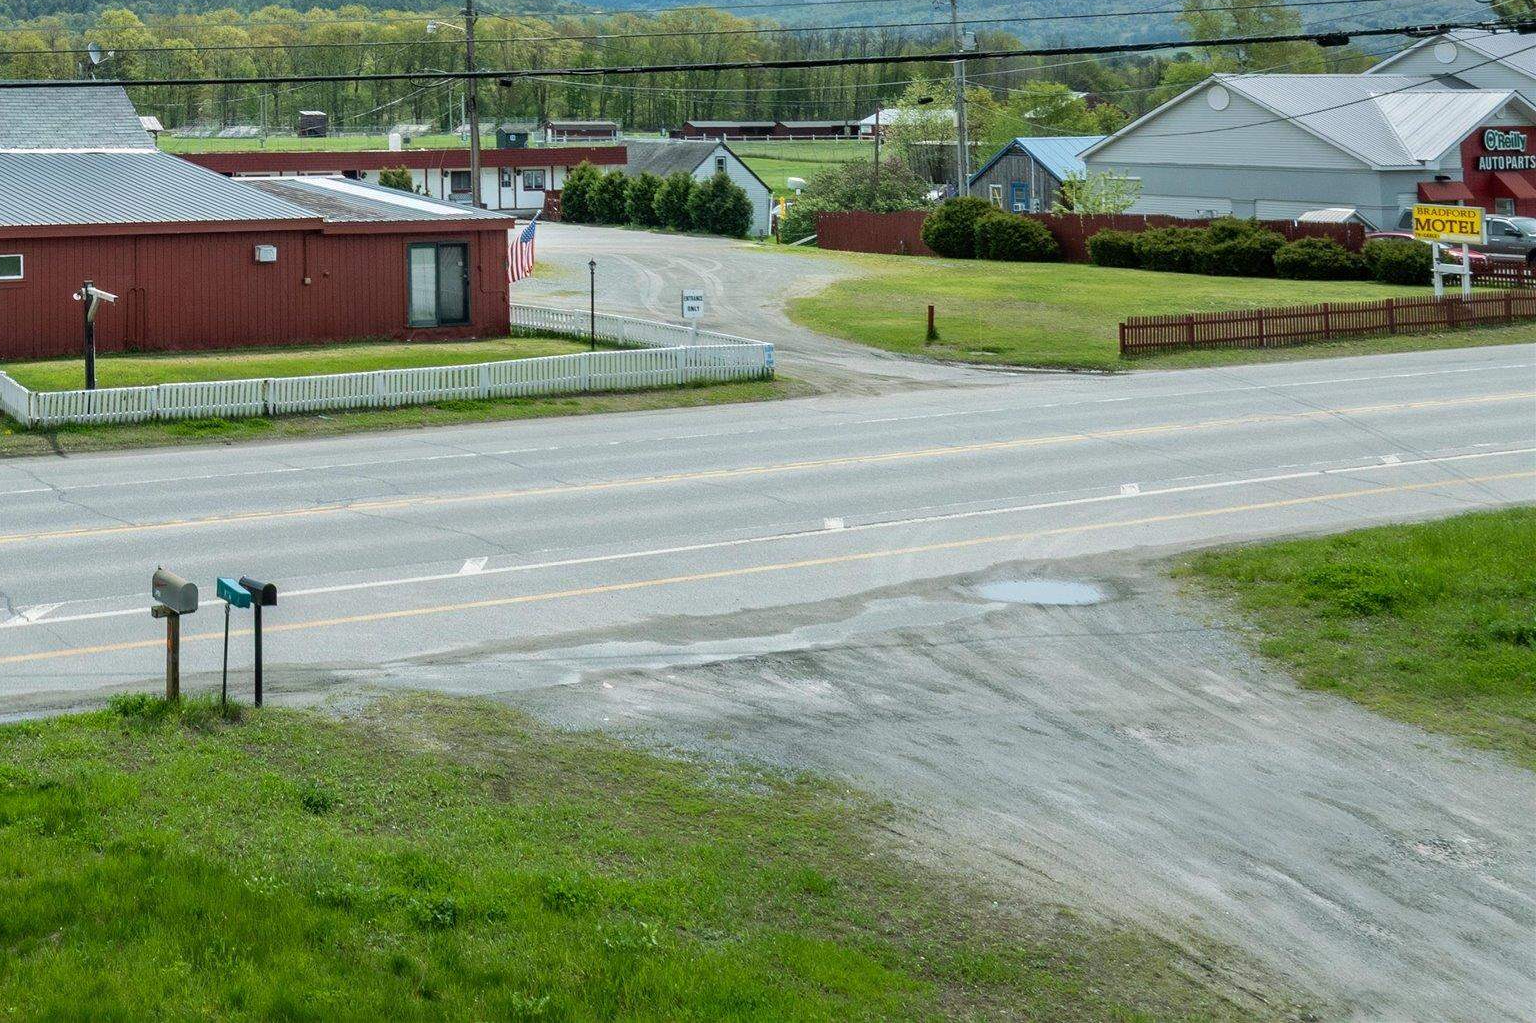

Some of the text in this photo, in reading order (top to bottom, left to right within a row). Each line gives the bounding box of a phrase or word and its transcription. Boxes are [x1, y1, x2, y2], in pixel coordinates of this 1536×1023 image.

[1484, 129, 1527, 152] O'Reilly
[1479, 155, 1536, 170] AUTO PARTS
[1416, 207, 1476, 218] BRADFORD
[1414, 217, 1480, 235] MOTEL
